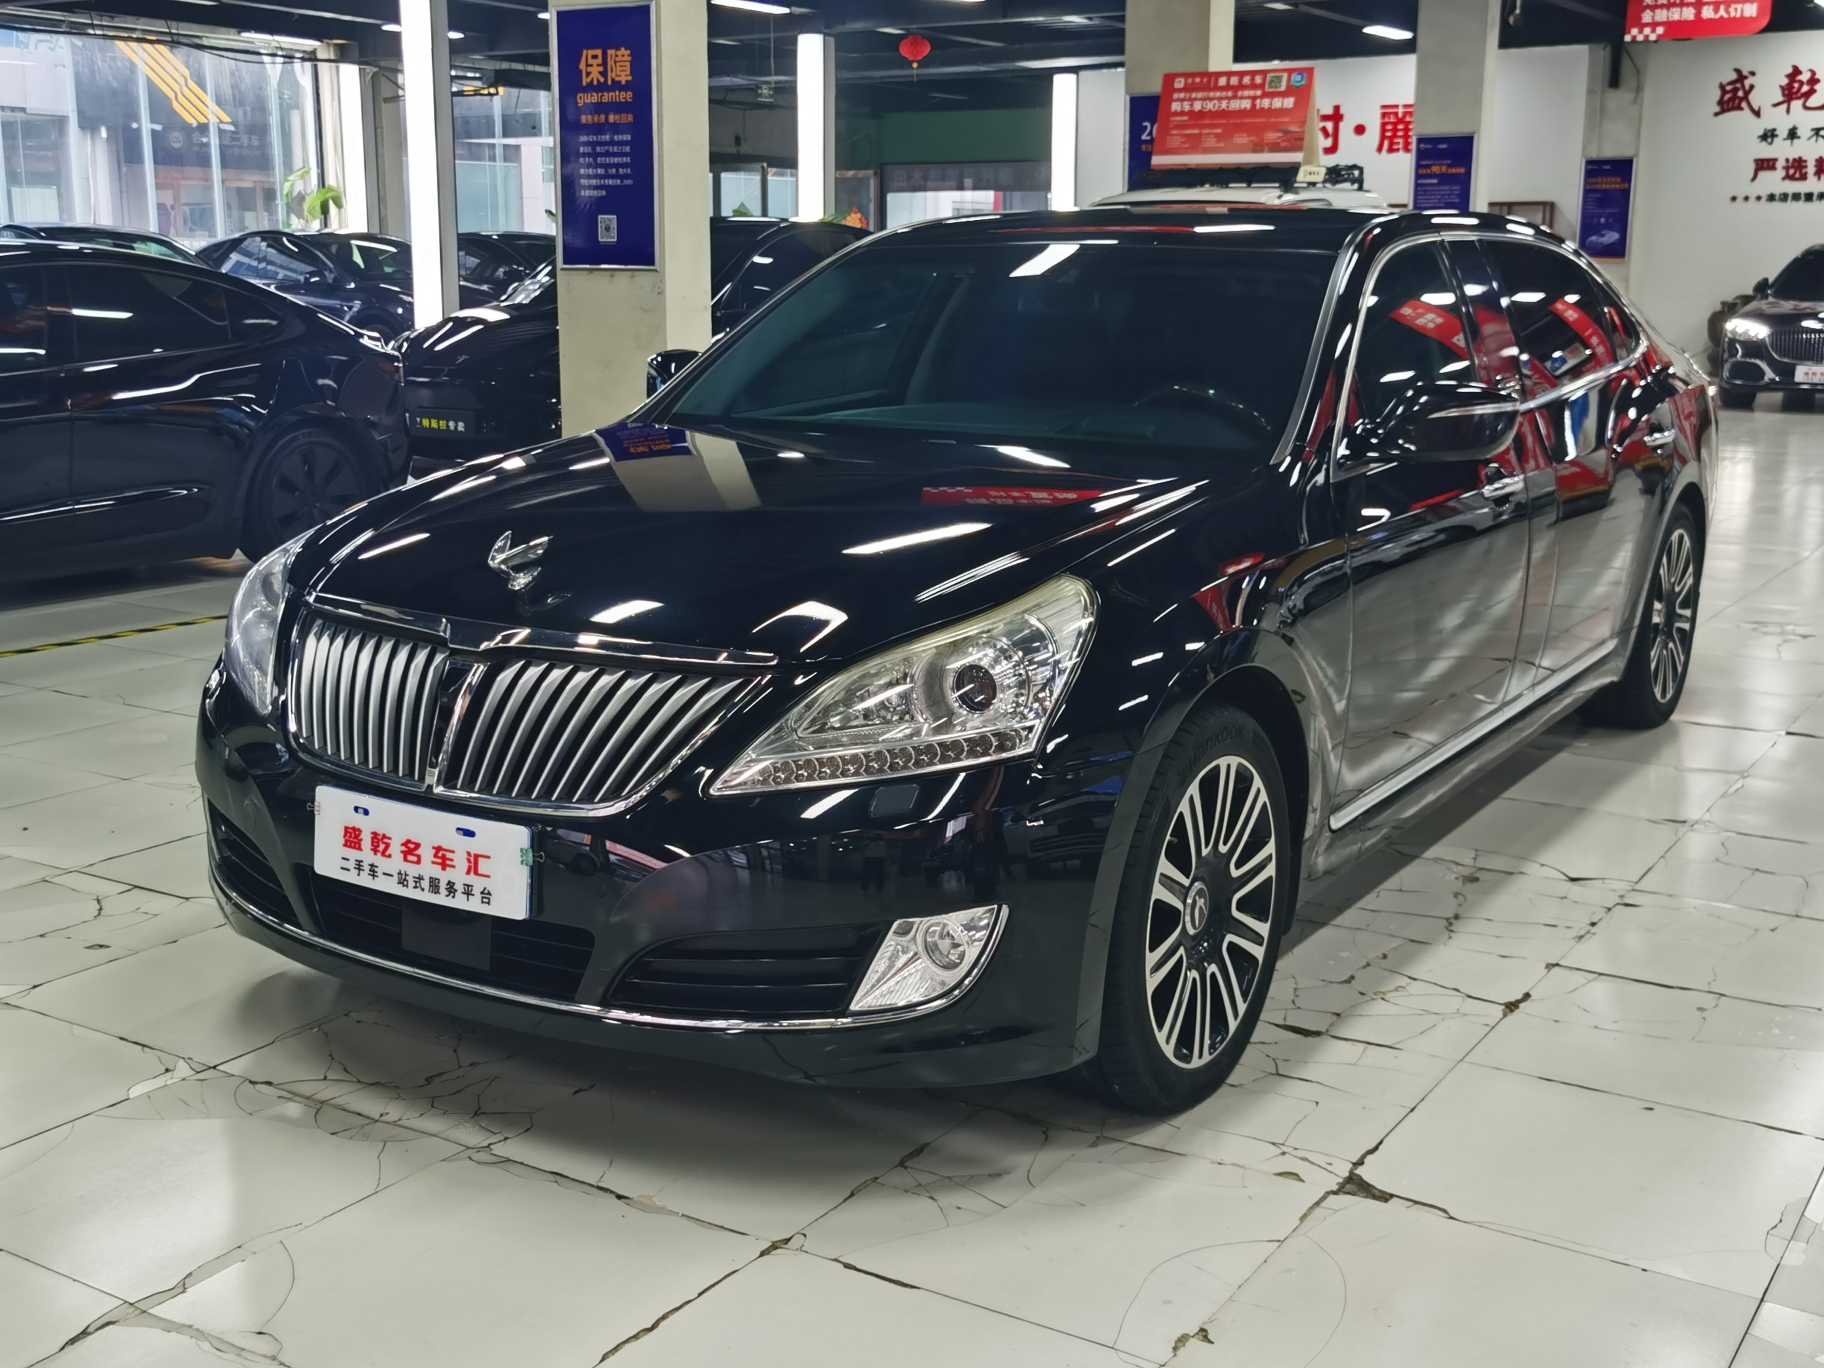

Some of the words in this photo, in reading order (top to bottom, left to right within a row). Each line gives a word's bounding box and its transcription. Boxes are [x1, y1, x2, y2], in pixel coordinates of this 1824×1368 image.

[579, 47, 633, 86] 保障
[577, 90, 633, 106] guarantee
[341, 825, 492, 879] 盛乾名车汇
[339, 855, 493, 906] 二手车一站式服务平台
